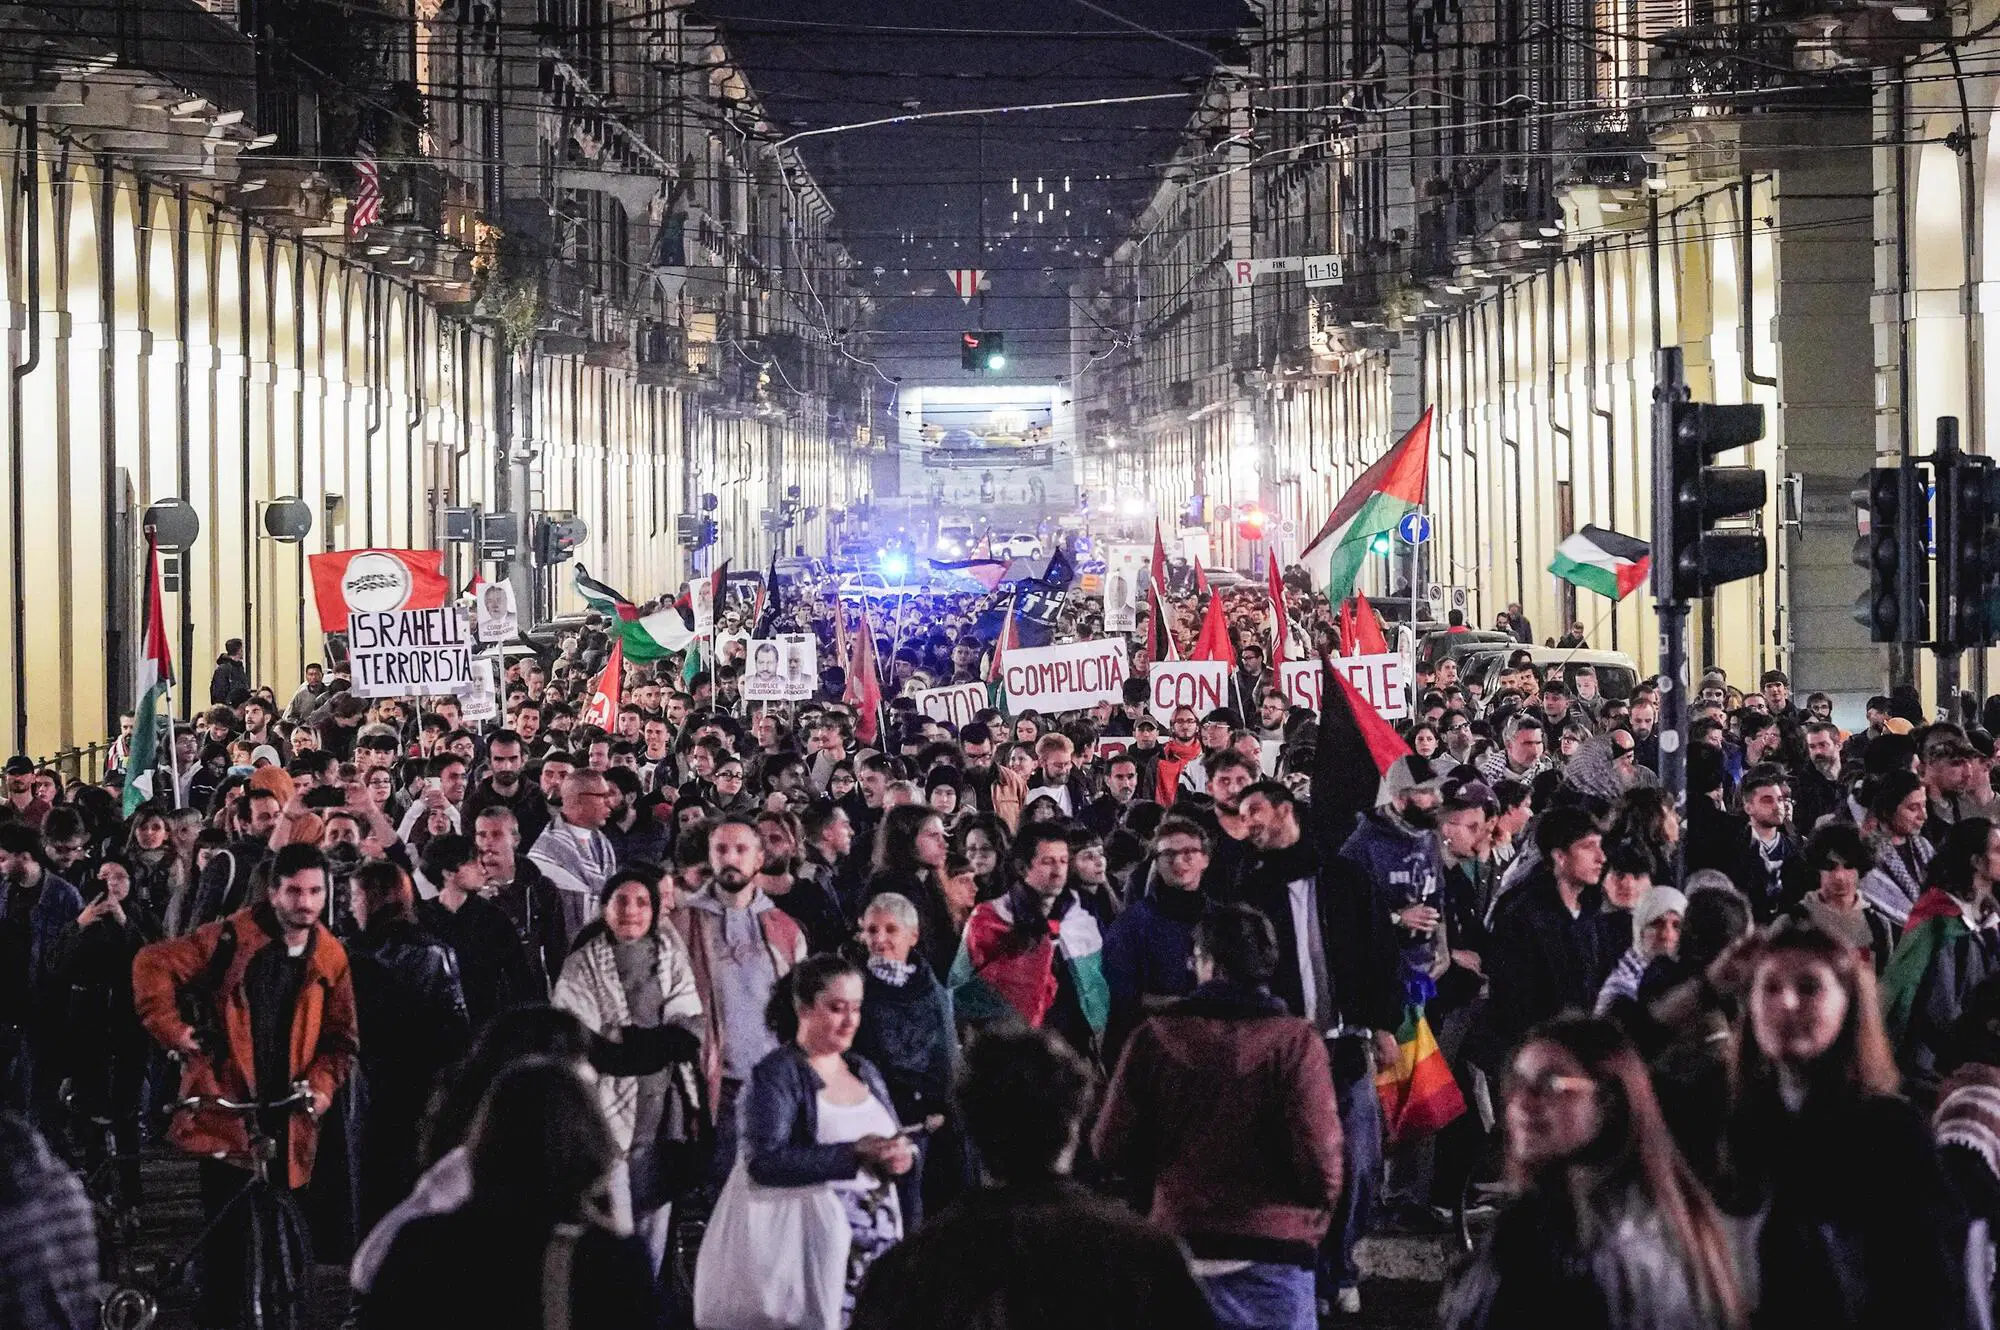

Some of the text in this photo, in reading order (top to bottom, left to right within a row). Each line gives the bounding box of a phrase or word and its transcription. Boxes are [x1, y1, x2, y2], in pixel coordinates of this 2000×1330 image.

[1236, 261, 1252, 284] R
[1272, 260, 1286, 269] FINE
[1307, 262, 1339, 279] 11-19
[351, 607, 465, 648] ISRAHELL
[356, 648, 474, 686] TERRORISTA
[1006, 645, 1124, 697] COMPLICITÀ
[1154, 672, 1221, 709] CON
